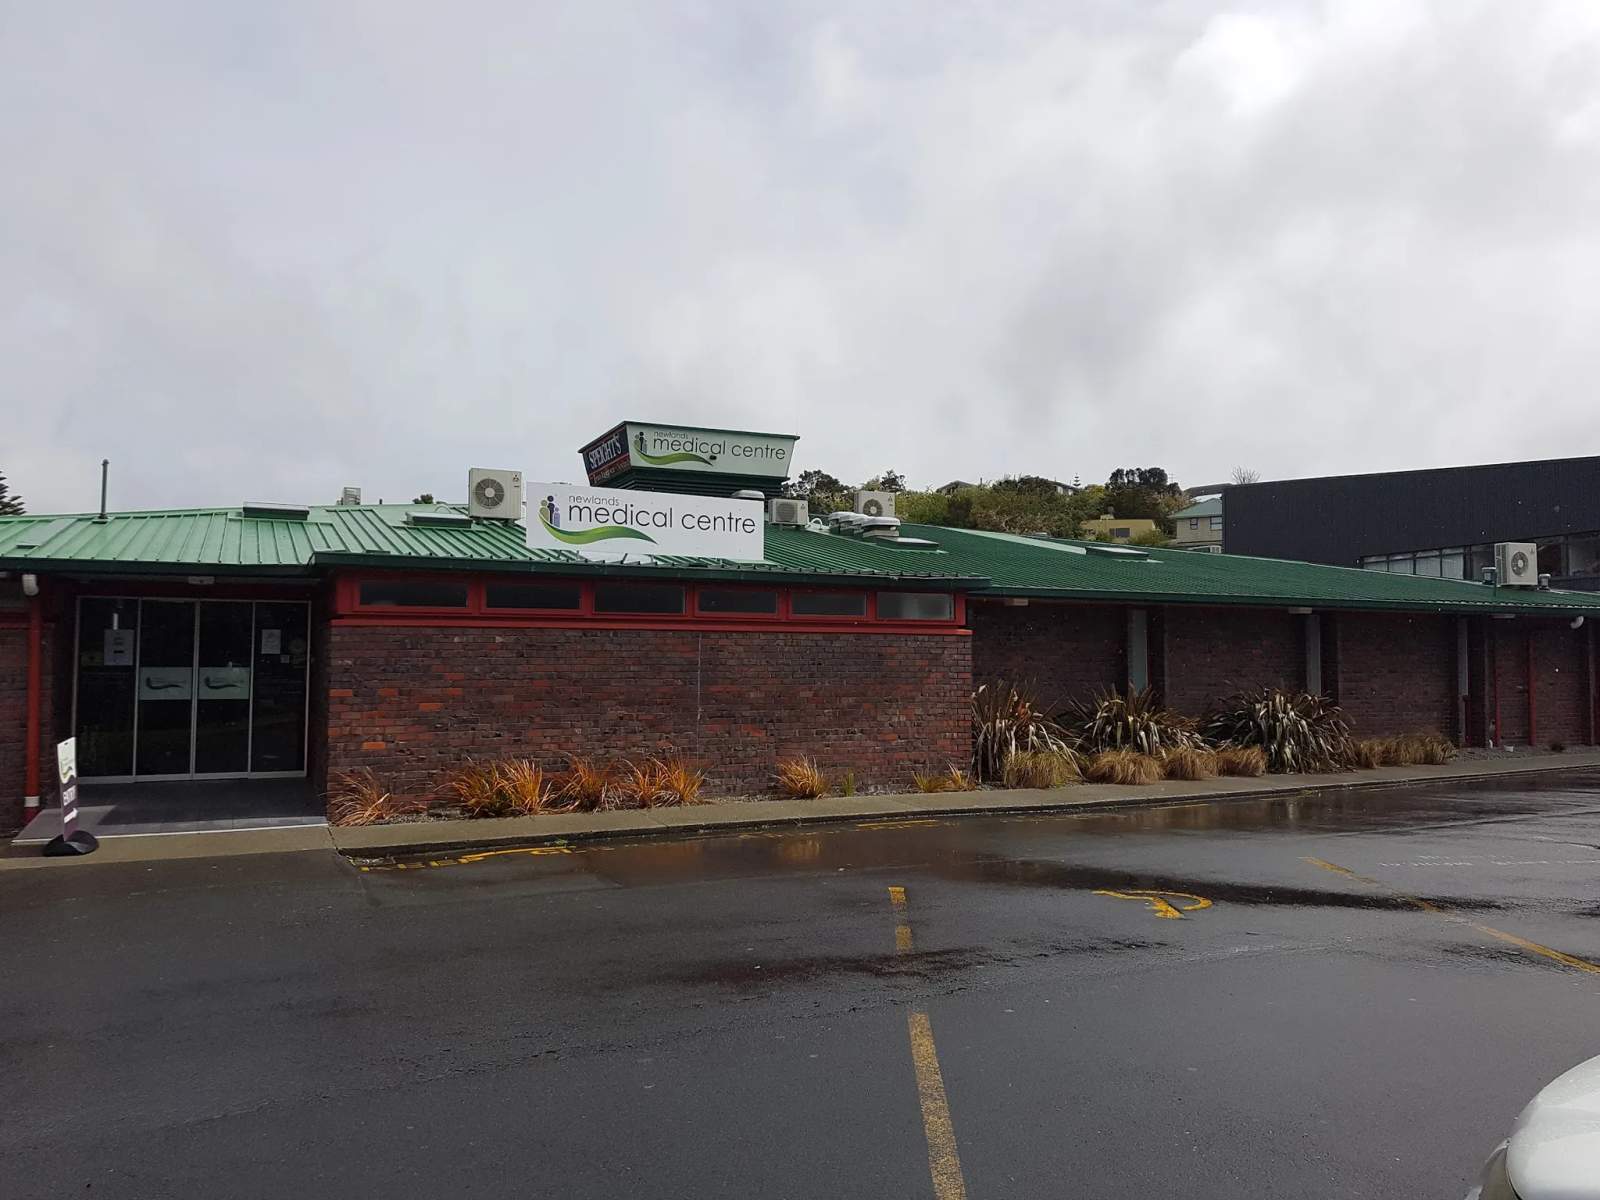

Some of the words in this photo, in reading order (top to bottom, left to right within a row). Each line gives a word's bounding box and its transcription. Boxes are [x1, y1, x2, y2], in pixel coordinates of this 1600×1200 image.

[654, 431, 689, 439] newlands
[653, 437, 726, 455] medical
[731, 444, 786, 460] centre
[568, 495, 620, 506] newlands
[569, 503, 673, 528] medical
[681, 512, 756, 534] centre
